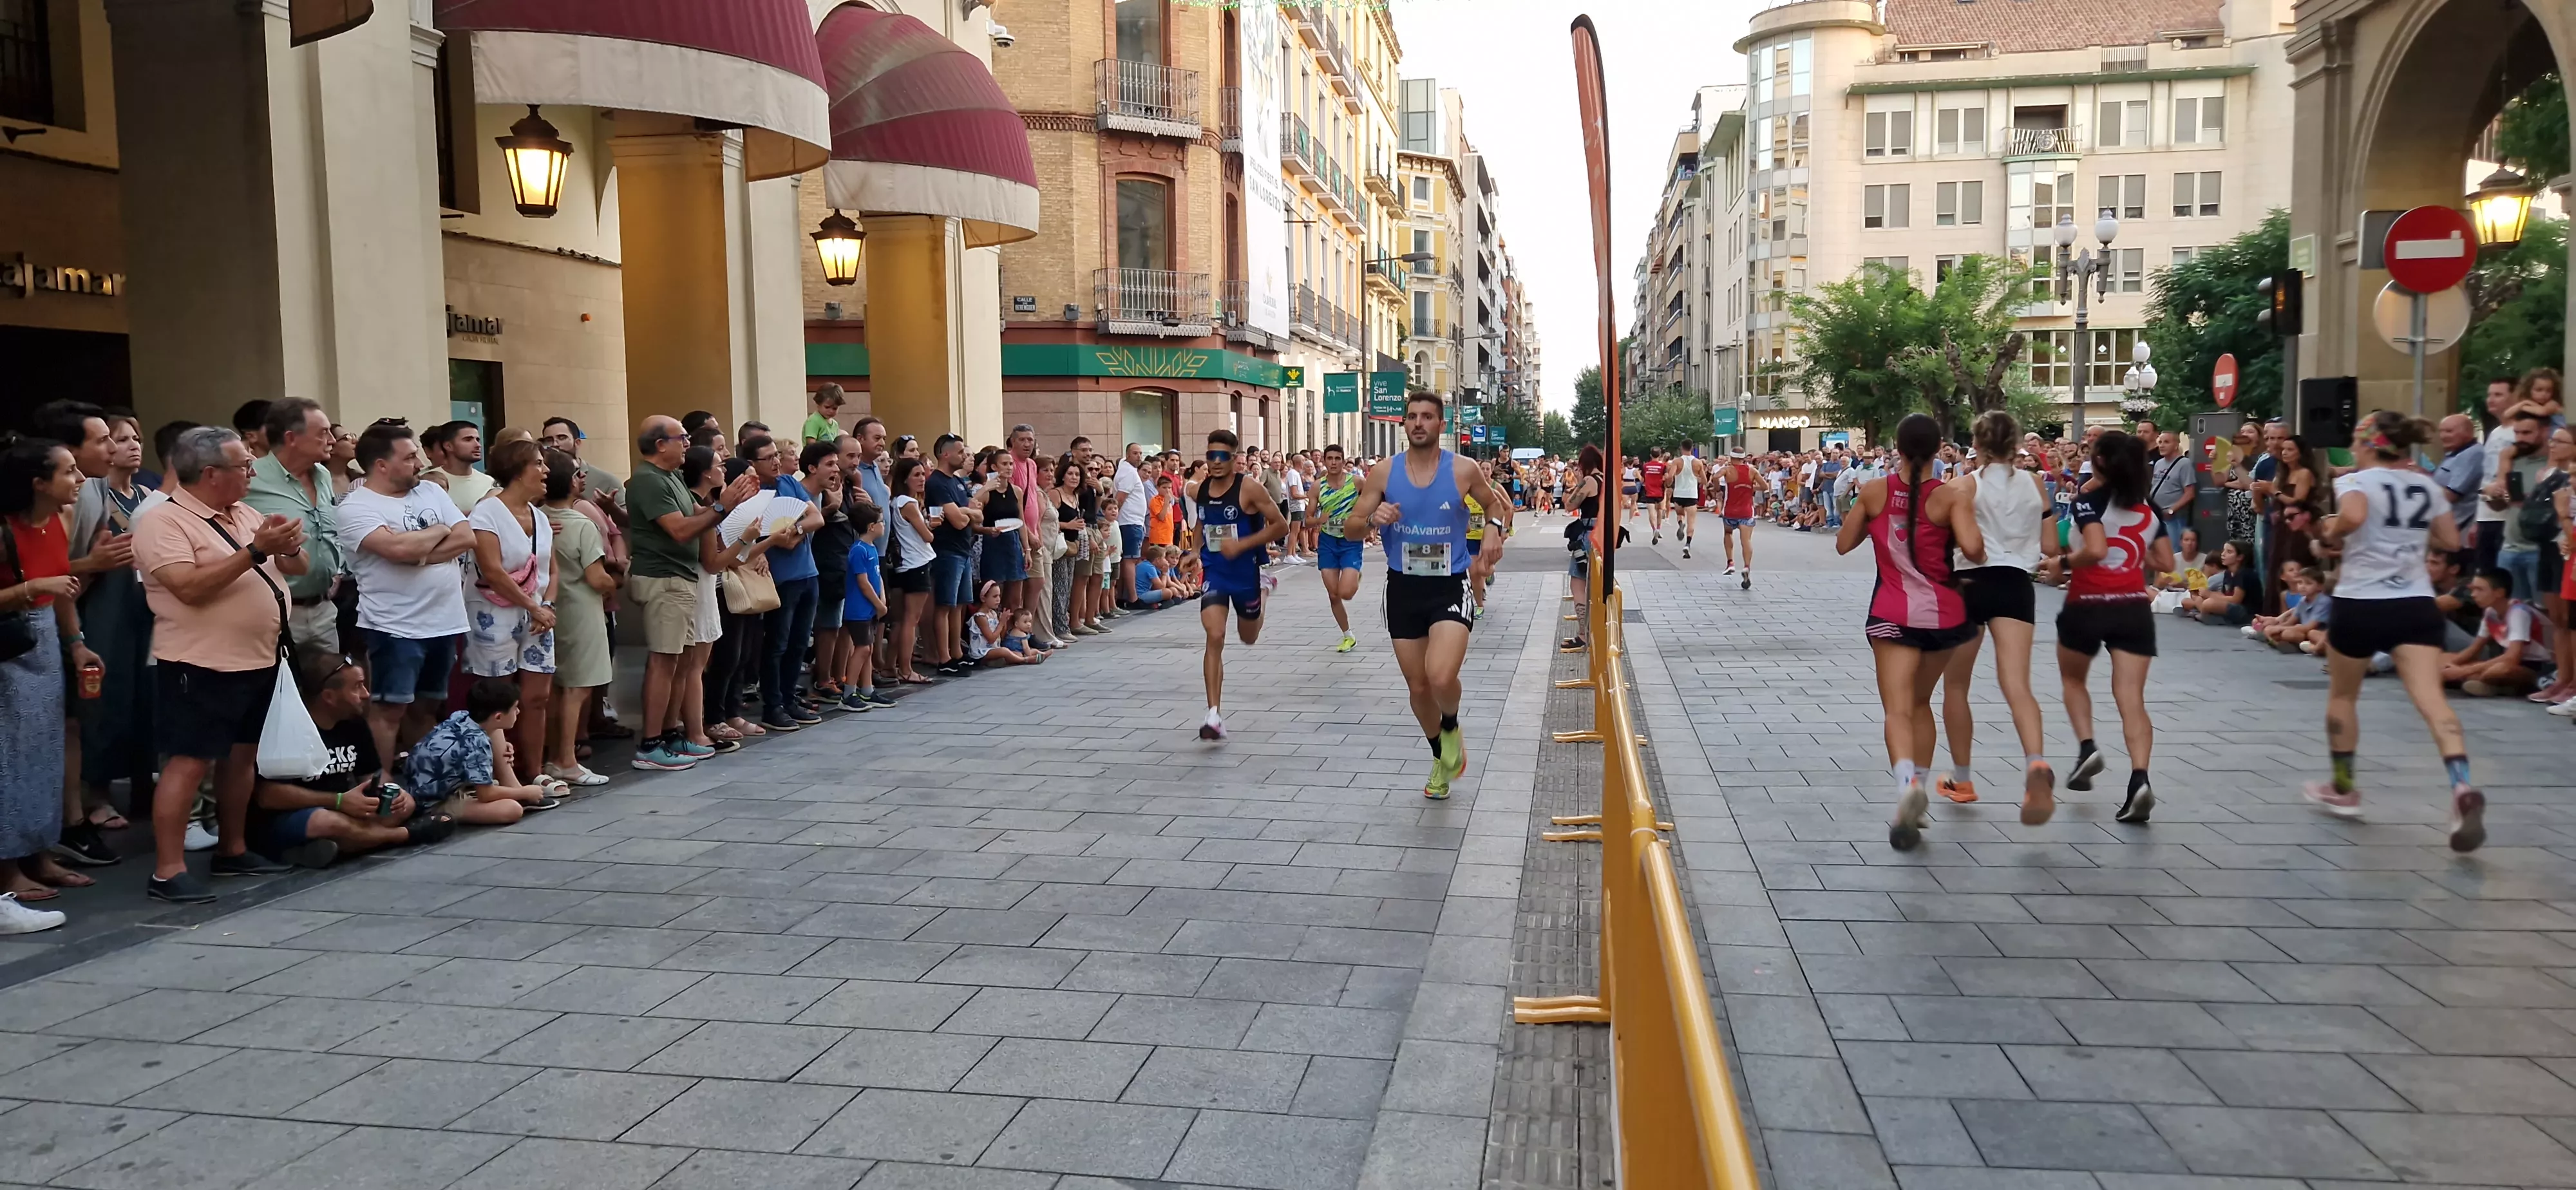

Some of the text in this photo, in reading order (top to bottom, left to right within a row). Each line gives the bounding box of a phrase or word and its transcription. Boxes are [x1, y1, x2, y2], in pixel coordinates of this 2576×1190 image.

[1249, 174, 1259, 198] SAN
[0, 252, 127, 297] ajamar
[1759, 416, 1810, 429] MANGO
[2382, 484, 2431, 529] 12
[1215, 525, 1223, 534] 6
[1393, 522, 1451, 535] OrtoAvanza
[1422, 544, 1431, 554] 8
[328, 744, 358, 764] CK&
